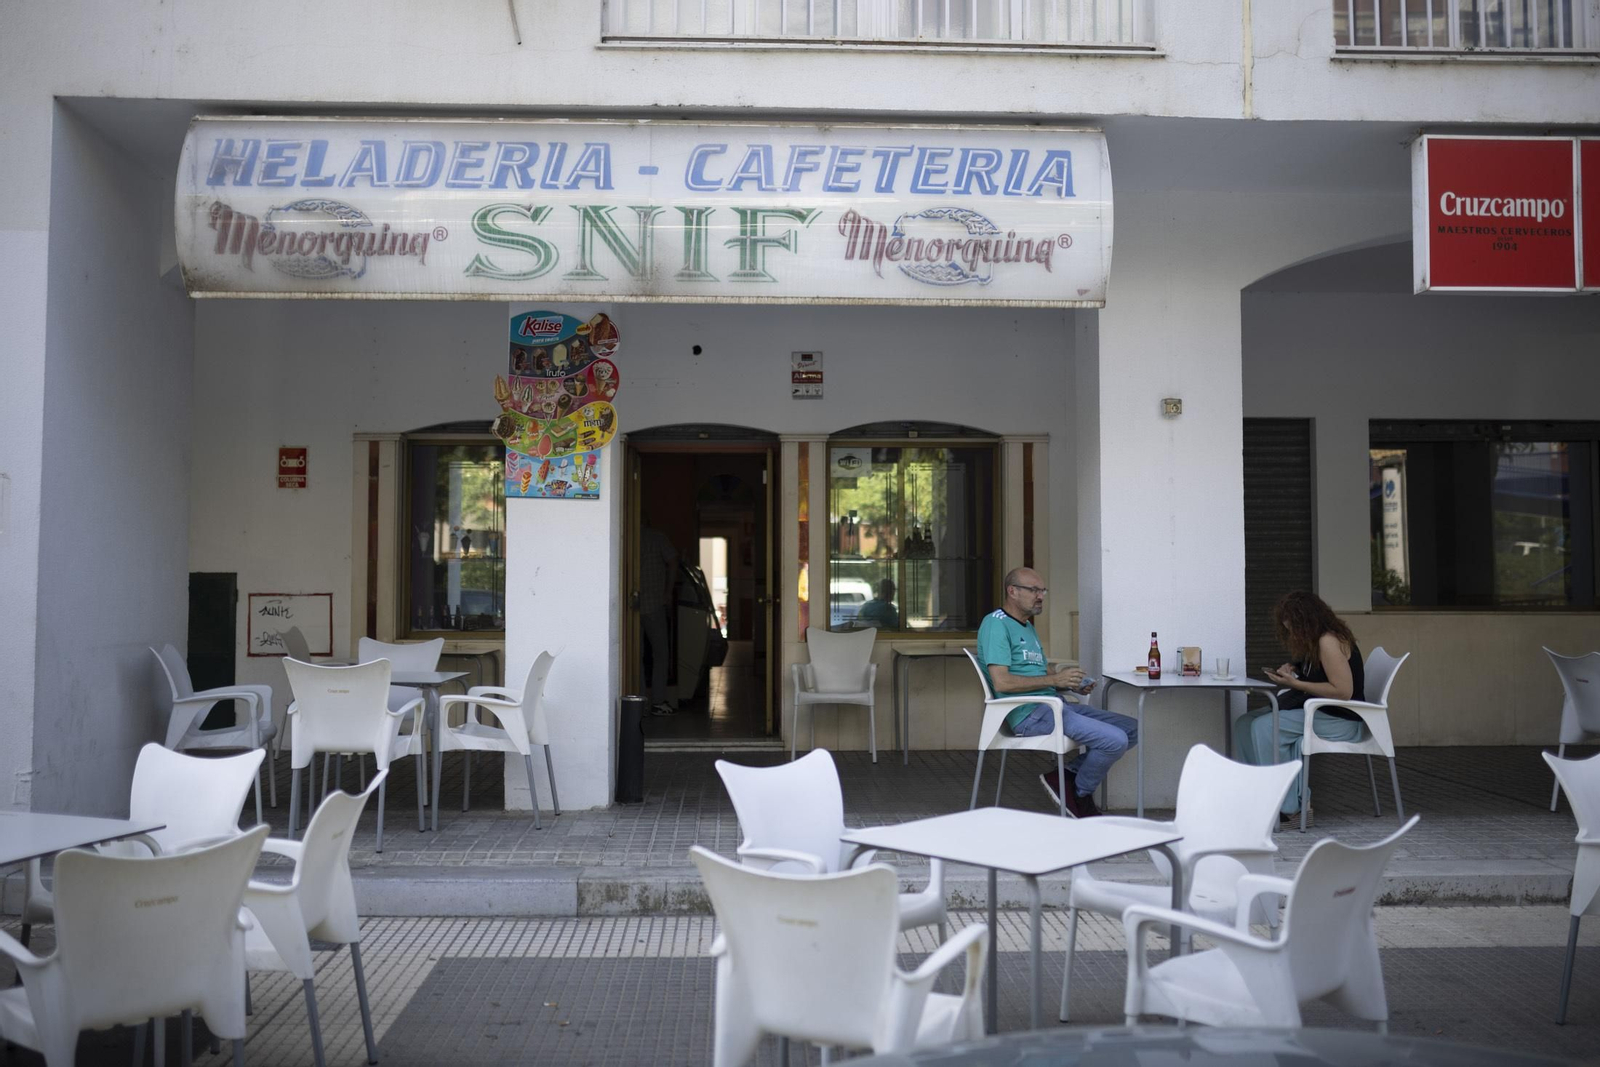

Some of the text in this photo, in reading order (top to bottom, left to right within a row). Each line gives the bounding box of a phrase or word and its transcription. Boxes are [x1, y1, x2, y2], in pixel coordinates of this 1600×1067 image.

[205, 138, 615, 191] HELADERIA
[684, 143, 1077, 198] CAFETERIA
[1439, 191, 1566, 223] Cruzcampo
[463, 202, 824, 283] SNIF
[1437, 225, 1572, 237] MAESTROS CERVECEROS
[1492, 241, 1518, 252] 1904
[522, 316, 562, 337] Kalise
